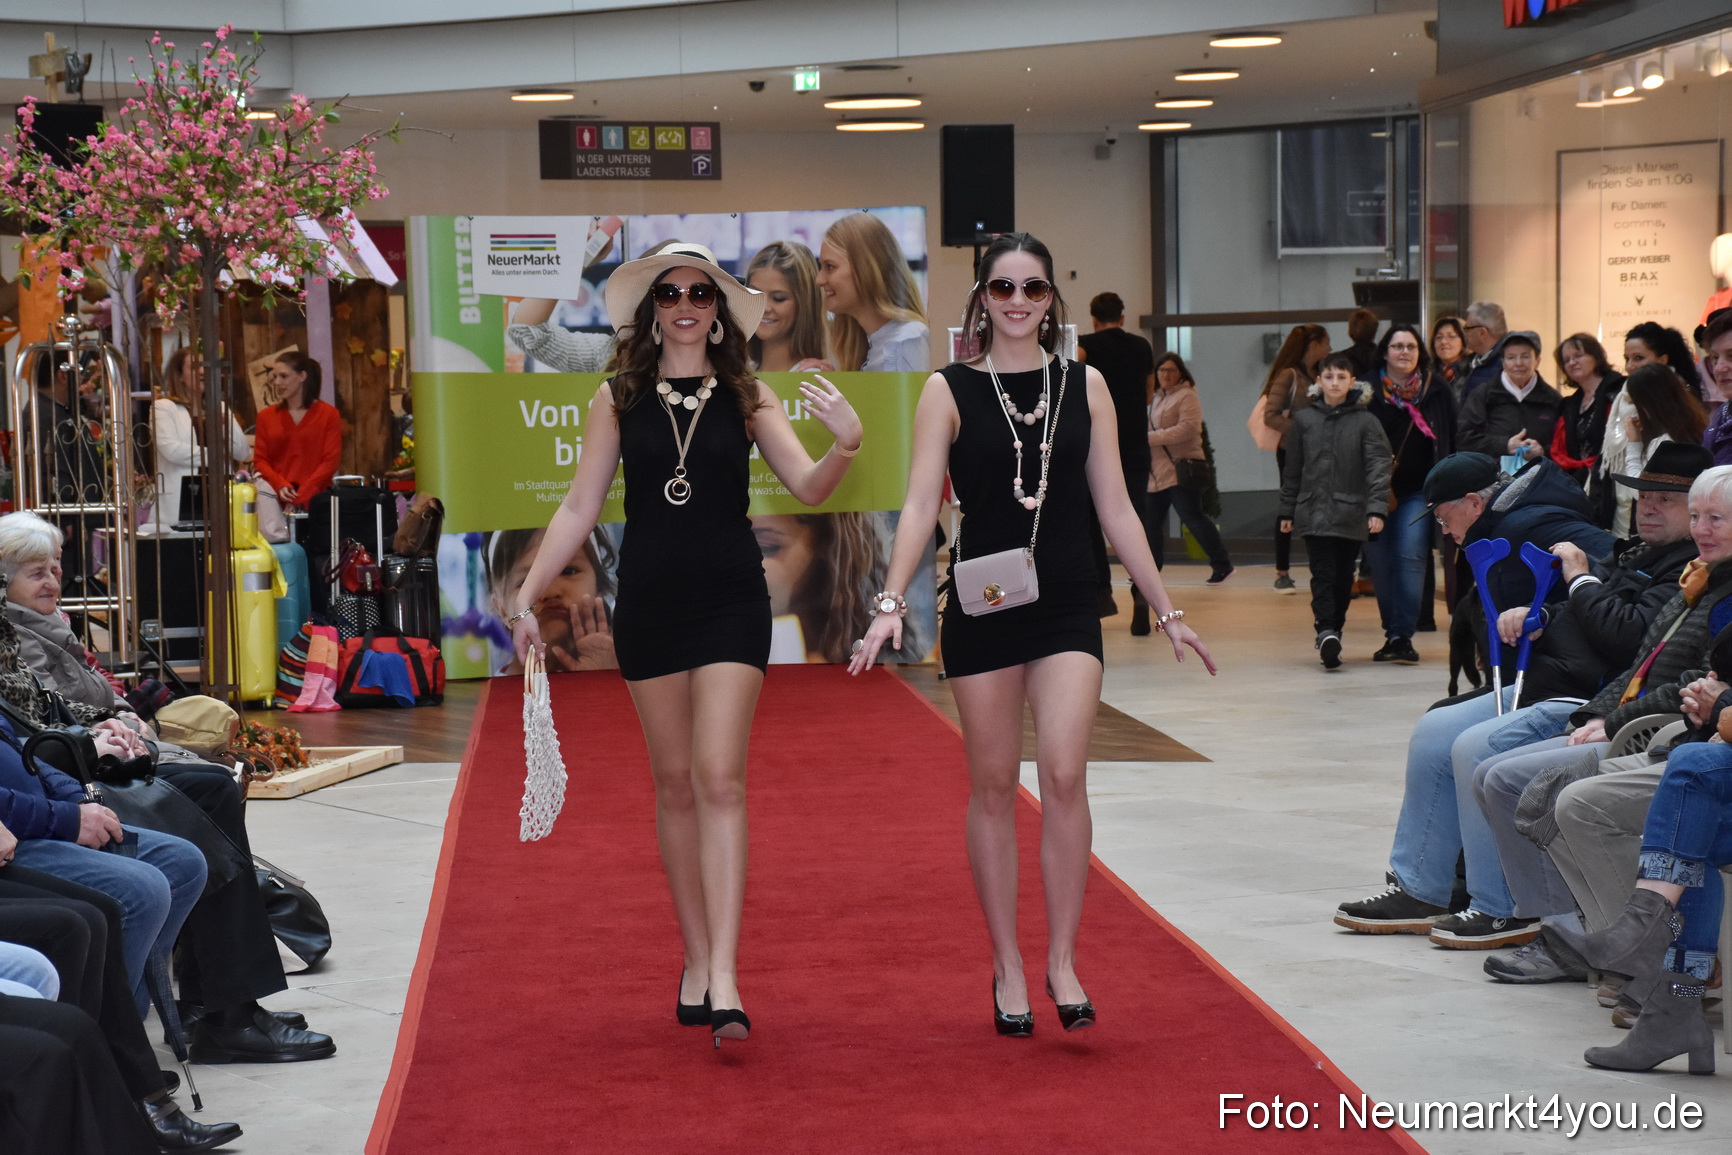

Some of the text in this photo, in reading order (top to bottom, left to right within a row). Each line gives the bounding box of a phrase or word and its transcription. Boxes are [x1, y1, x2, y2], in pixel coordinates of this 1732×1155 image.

[576, 154, 651, 164] IN DER UNTEREN
[577, 167, 651, 177] LADENSTRASSE
[1602, 162, 1679, 176] Diese Marken
[1587, 179, 1622, 190] finden
[1625, 176, 1643, 188] Sie
[1647, 176, 1662, 186] im
[487, 253, 561, 266] NeuerMarkt
[1608, 254, 1671, 266] GERRY WEBER
[542, 268, 560, 276] Dach.
[1620, 271, 1659, 282] BRAX
[519, 400, 580, 428] Von
[555, 436, 583, 466] bi
[514, 481, 525, 490] Im
[754, 487, 774, 495] was
